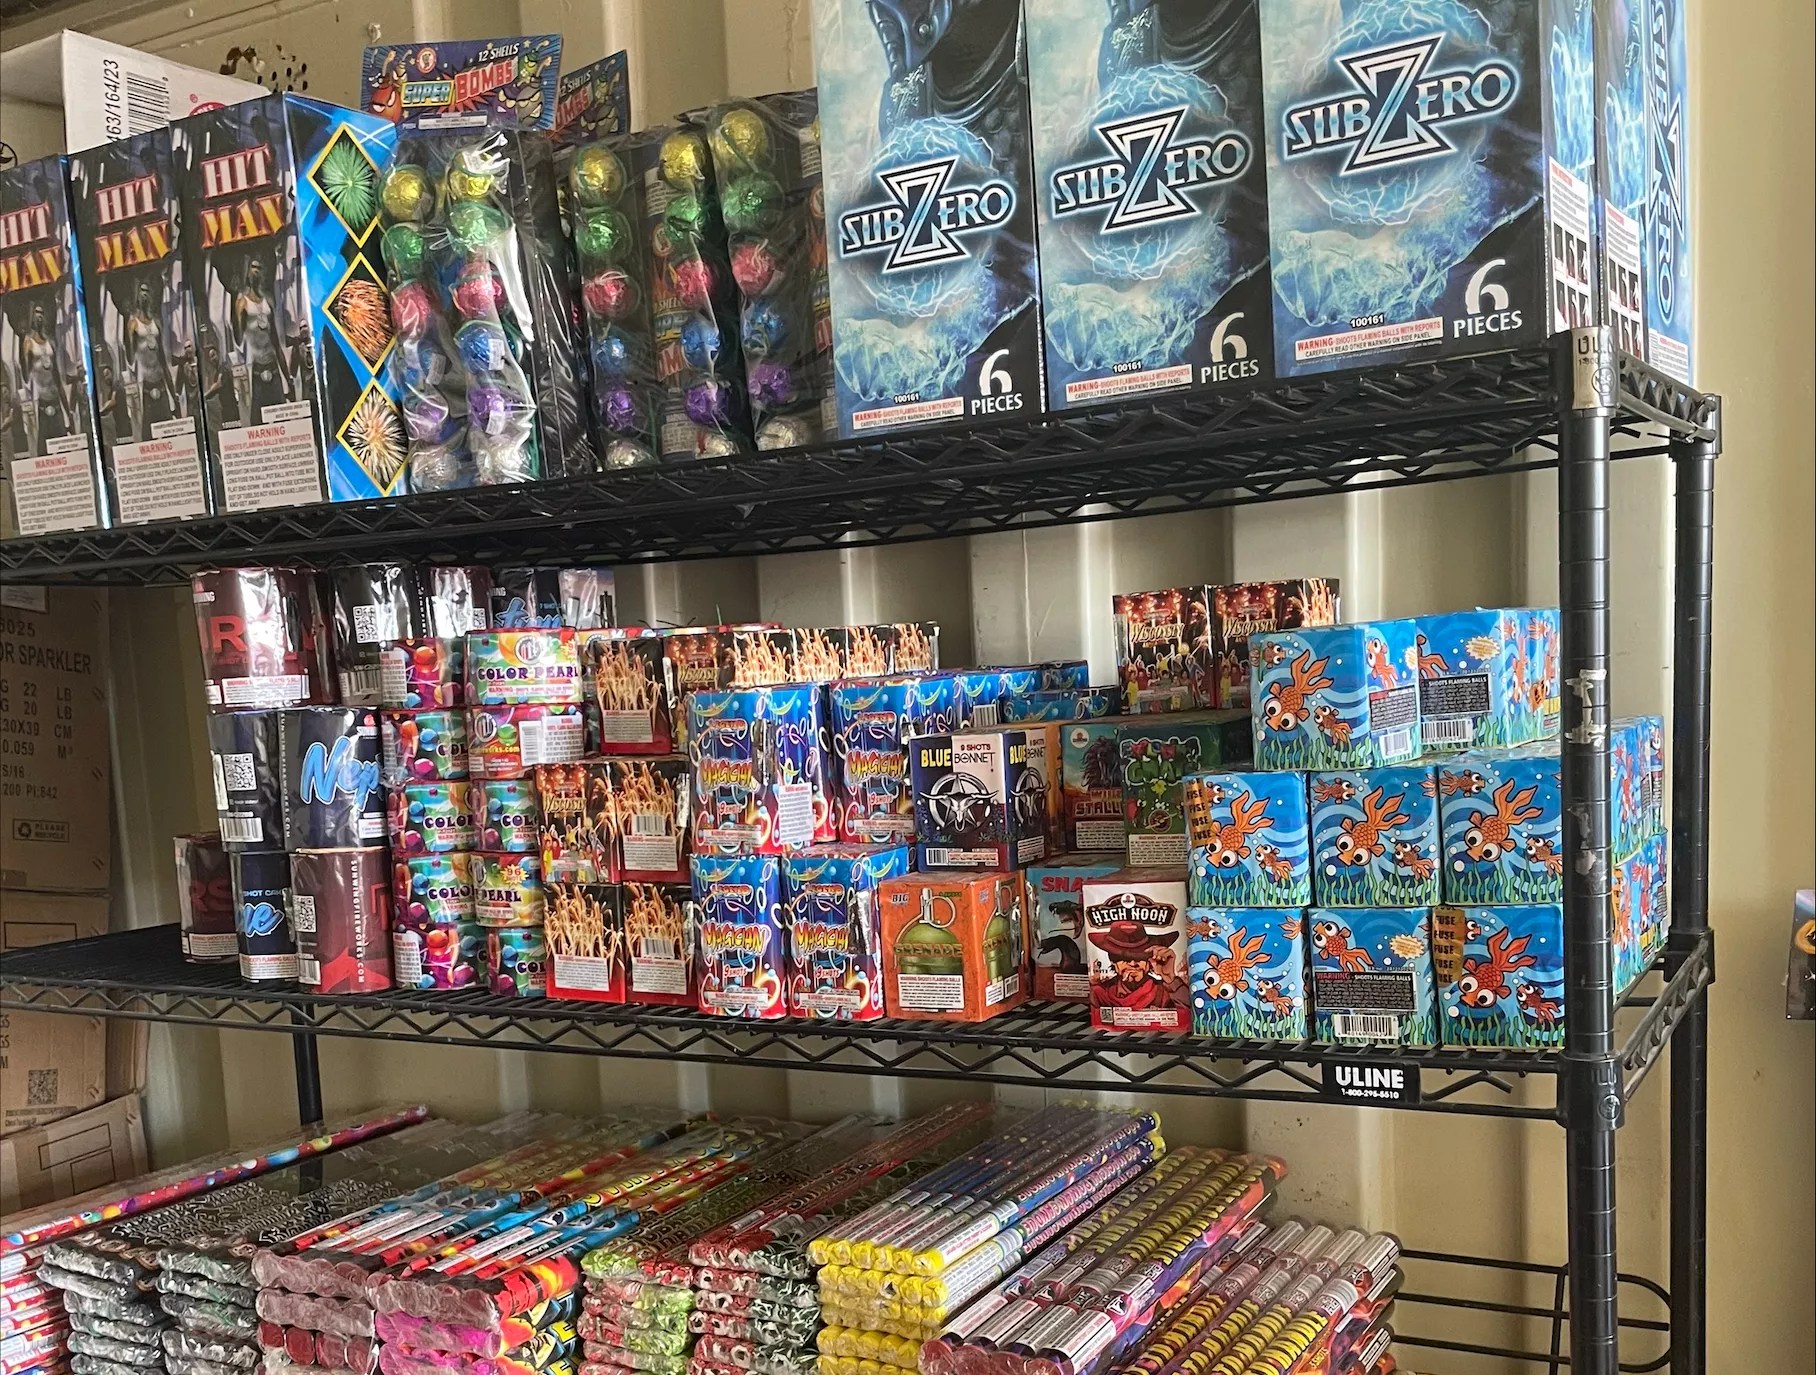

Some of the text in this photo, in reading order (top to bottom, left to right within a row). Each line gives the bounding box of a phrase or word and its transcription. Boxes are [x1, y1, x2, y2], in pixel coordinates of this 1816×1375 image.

[478, 43, 520, 62] 12 SHELLS
[455, 60, 519, 101] BOMBS
[402, 83, 452, 106] SUPER
[1286, 33, 1514, 174] SUBZERO
[201, 143, 272, 198] HIT
[1054, 106, 1248, 233] SUBZERO
[95, 173, 158, 225] HIT
[200, 193, 285, 249] MAN
[841, 155, 1014, 274] SUBZERO
[95, 219, 172, 273] MAN
[1464, 259, 1509, 315] 6
[1350, 314, 1385, 328] 100161
[1357, 331, 1381, 343] FLAMING
[1381, 328, 1400, 339] BALLS
[1400, 325, 1414, 335] WITH
[1414, 320, 1441, 333] REPORTS
[1453, 310, 1523, 339] PIECES
[1210, 312, 1249, 363] 6
[1305, 347, 1335, 358] CAREFULLY
[1335, 344, 1348, 353] READ
[1349, 341, 1366, 351] OTHER
[1367, 338, 1391, 349] WARNING
[1392, 336, 1400, 344] ON
[1401, 333, 1413, 343] SIDE
[978, 349, 1013, 395] 6
[1113, 361, 1142, 373] 100161
[1201, 359, 1260, 385] PIECES
[894, 393, 919, 403] 100161
[970, 393, 1024, 416] PIECES
[247, 426, 286, 440] WARNING
[139, 441, 173, 454] WARNING
[19, 646, 91, 675] SPARKLER
[477, 667, 528, 680] COLOR
[23, 682, 37, 698] 22
[57, 686, 72, 702] LB
[24, 701, 37, 716] 20
[57, 705, 72, 721] LB
[54, 723, 72, 740] CM
[967, 743, 991, 751] SHOTS
[1009, 745, 1027, 764] BLUE
[921, 749, 996, 767] BLUE BONNET
[701, 757, 752, 788] MAGICIA
[1075, 801, 1123, 816] STALL
[35, 823, 65, 832] PLEASE
[502, 814, 538, 827] COL
[1041, 876, 1083, 893] SNA
[1092, 907, 1168, 923] HIGH NOON
[702, 921, 766, 954] MAGICIAN
[793, 920, 849, 953] MAGICIA
[894, 943, 963, 957] GRENADE
[516, 960, 545, 974] COL
[1316, 972, 1350, 980] WARNING
[1335, 1066, 1404, 1089] ULINE
[1341, 1088, 1399, 1099] 1-800-295-5510
